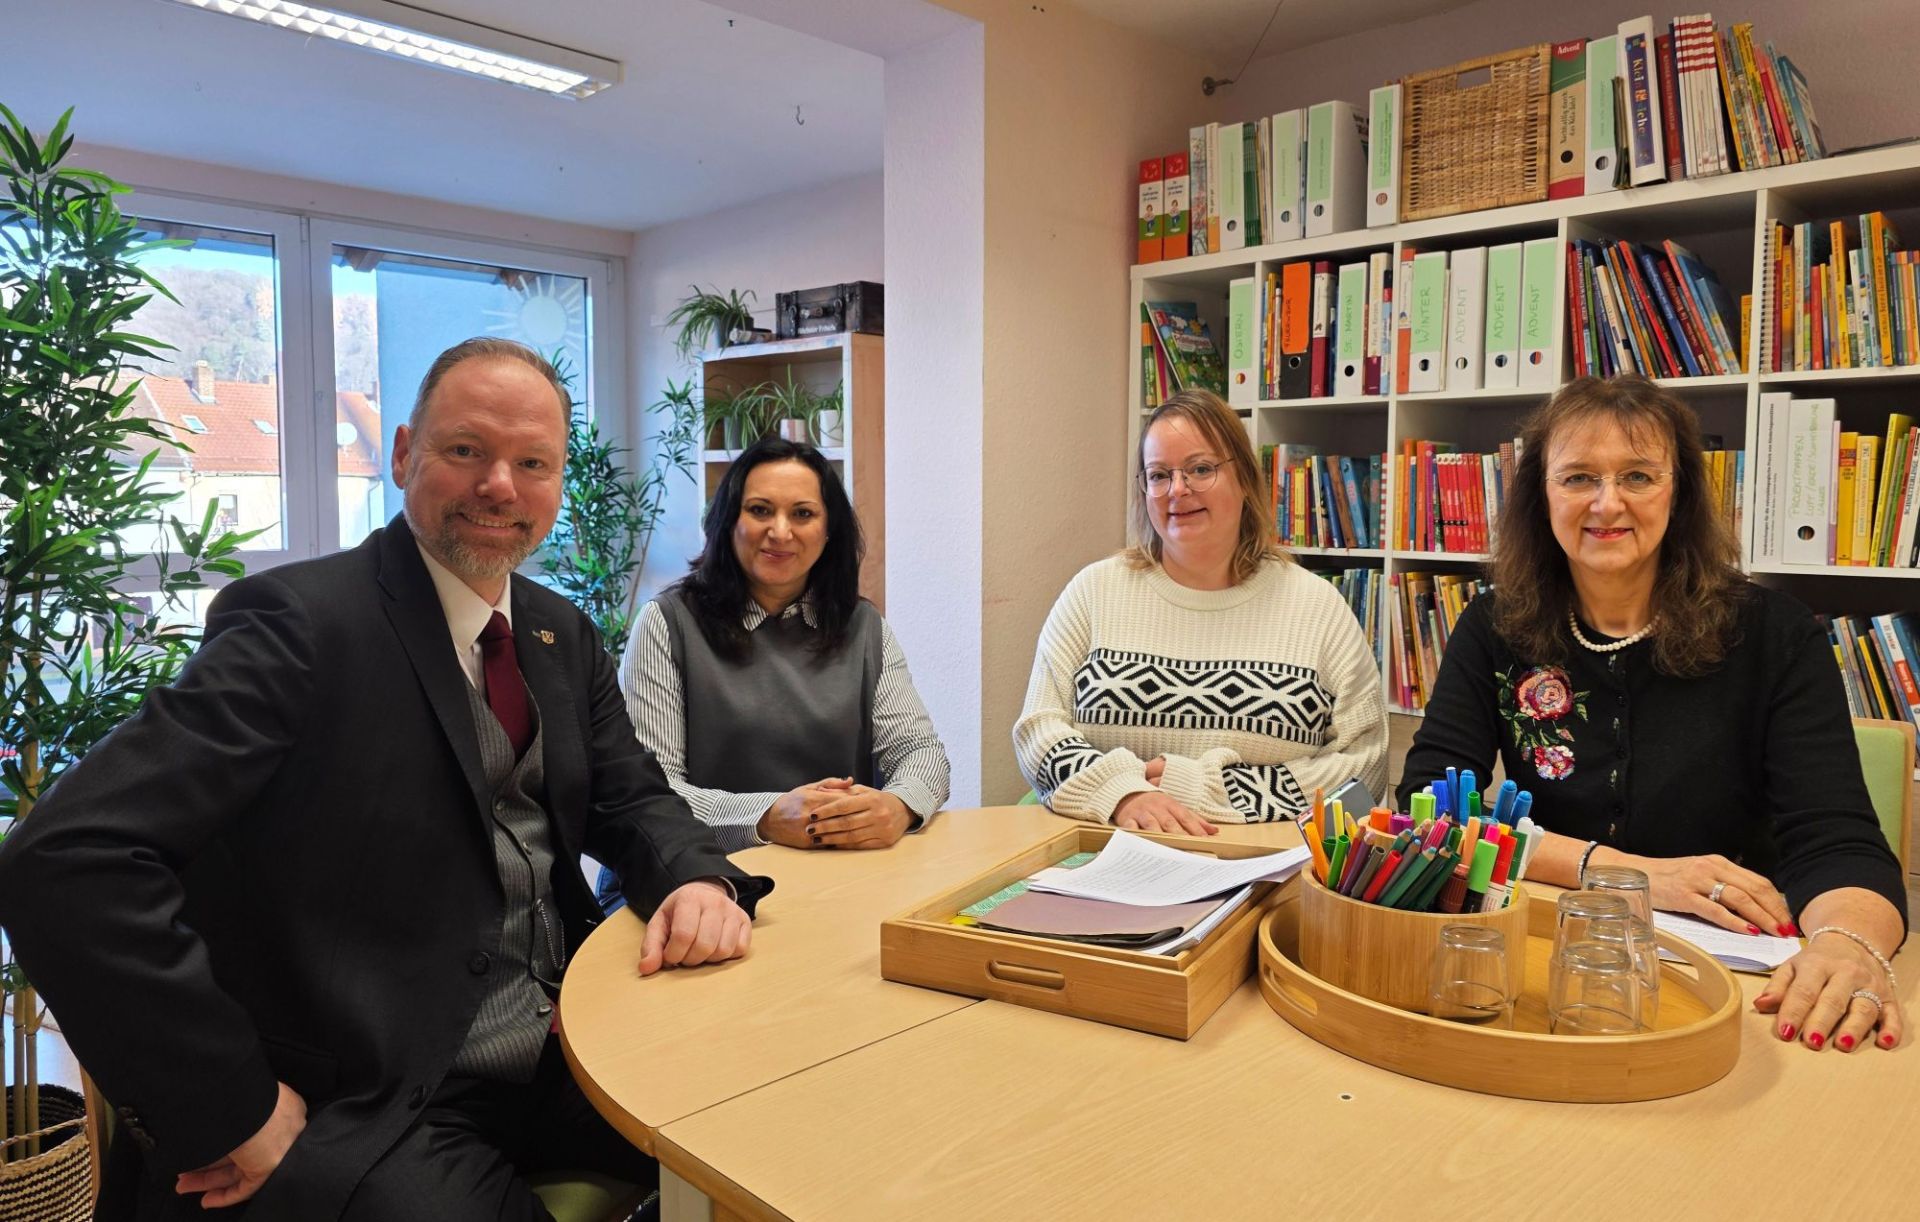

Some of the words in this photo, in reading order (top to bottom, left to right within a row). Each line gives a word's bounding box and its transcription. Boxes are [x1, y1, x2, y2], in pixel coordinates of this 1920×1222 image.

[1557, 42, 1581, 56] Advent
[1233, 313, 1244, 360] OSTERN
[1415, 286, 1431, 345] WINTER
[1456, 286, 1468, 343] ADVENT
[1493, 279, 1504, 339] ADVENT
[1528, 283, 1541, 339] ADVENT
